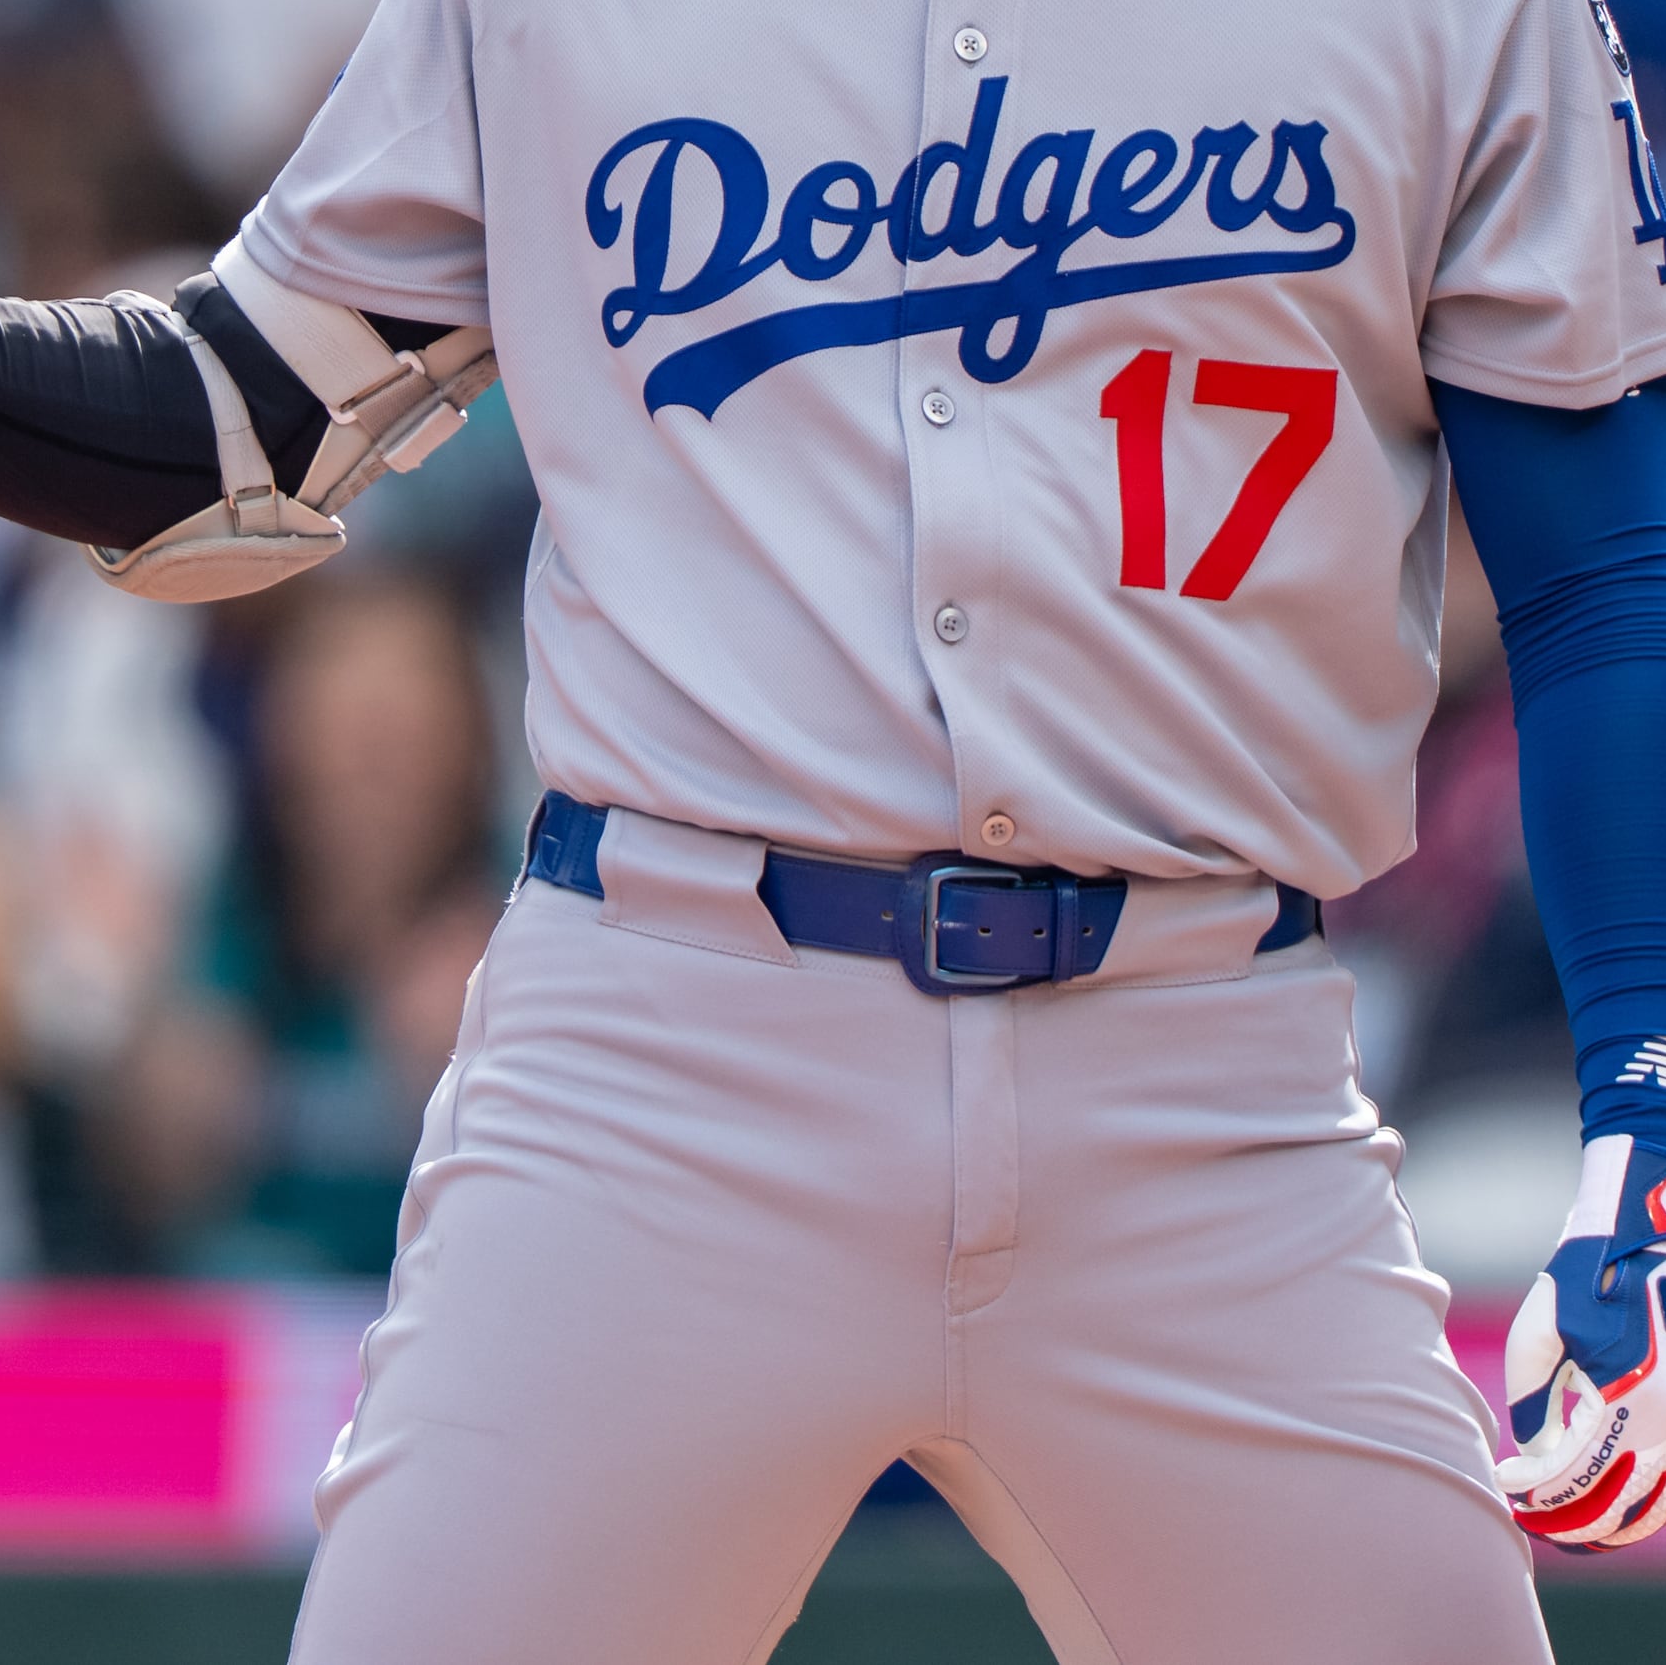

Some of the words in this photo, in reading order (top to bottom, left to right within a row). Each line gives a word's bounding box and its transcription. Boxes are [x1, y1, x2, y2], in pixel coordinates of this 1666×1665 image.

[586, 75, 1356, 422] Dodgers
[1100, 349, 1338, 602] 17
[1540, 1486, 1577, 1507] new
[1572, 1407, 1629, 1488] balance
